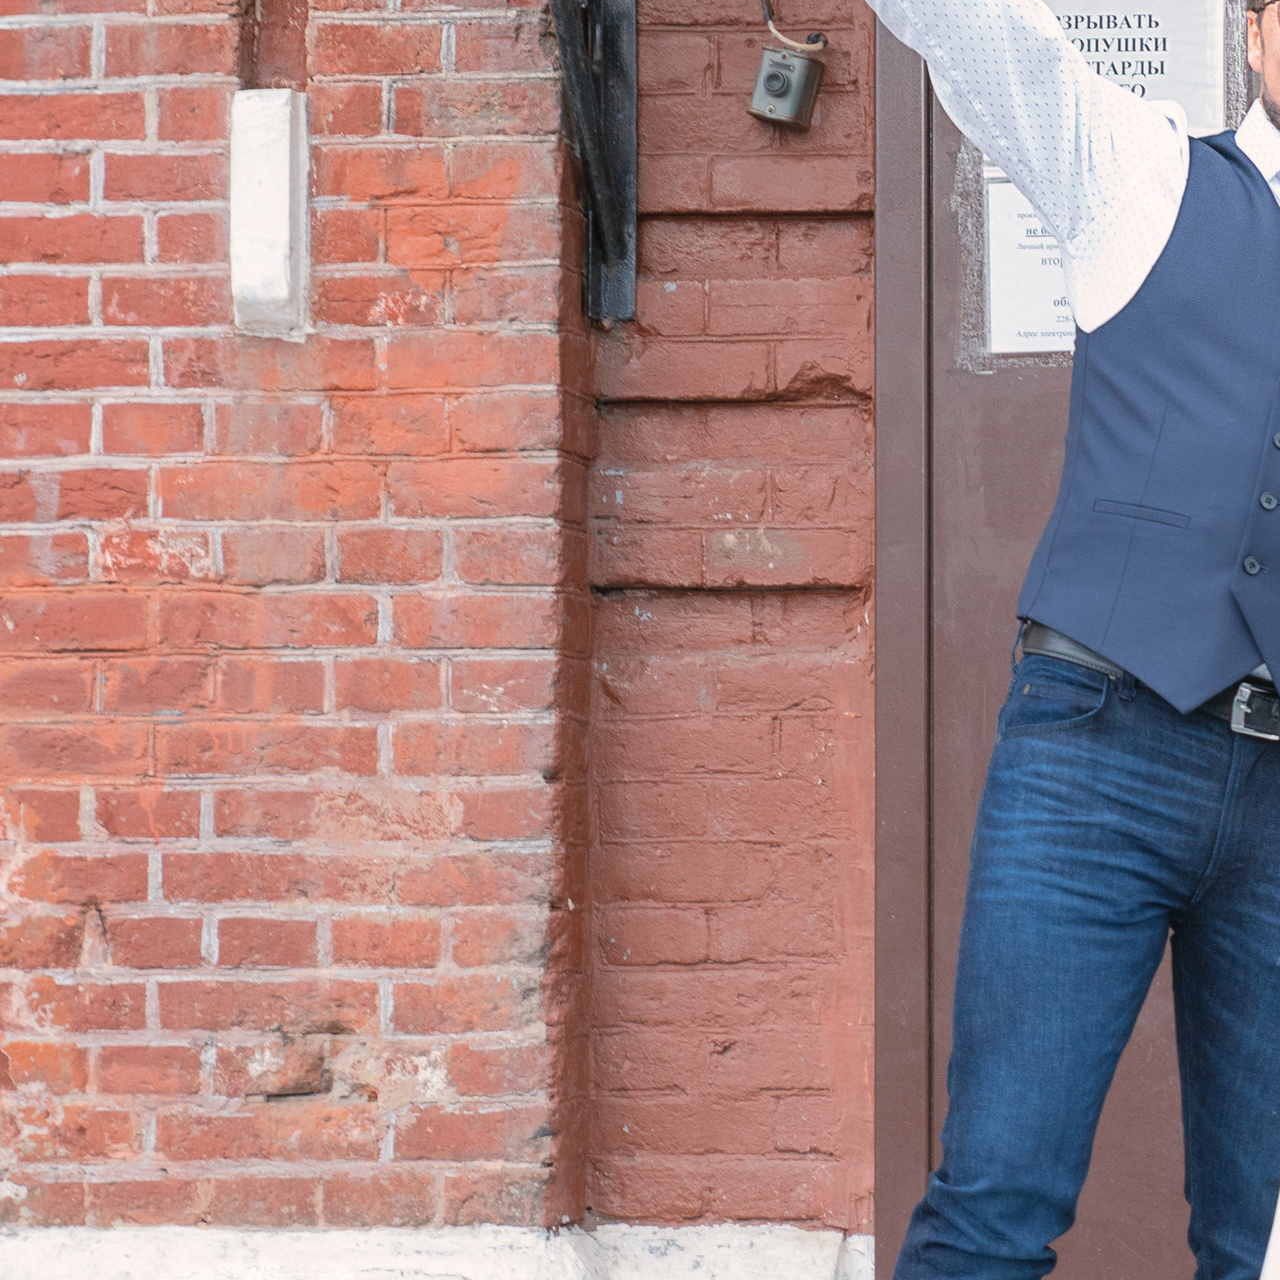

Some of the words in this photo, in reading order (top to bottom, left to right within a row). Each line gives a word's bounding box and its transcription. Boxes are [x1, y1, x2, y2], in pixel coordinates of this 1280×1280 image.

[1056, 13, 1160, 30] ЗРЫВАТЬ
[1070, 36, 1168, 53] ОПУШКИ
[1086, 59, 1166, 79] ТАРДЫ
